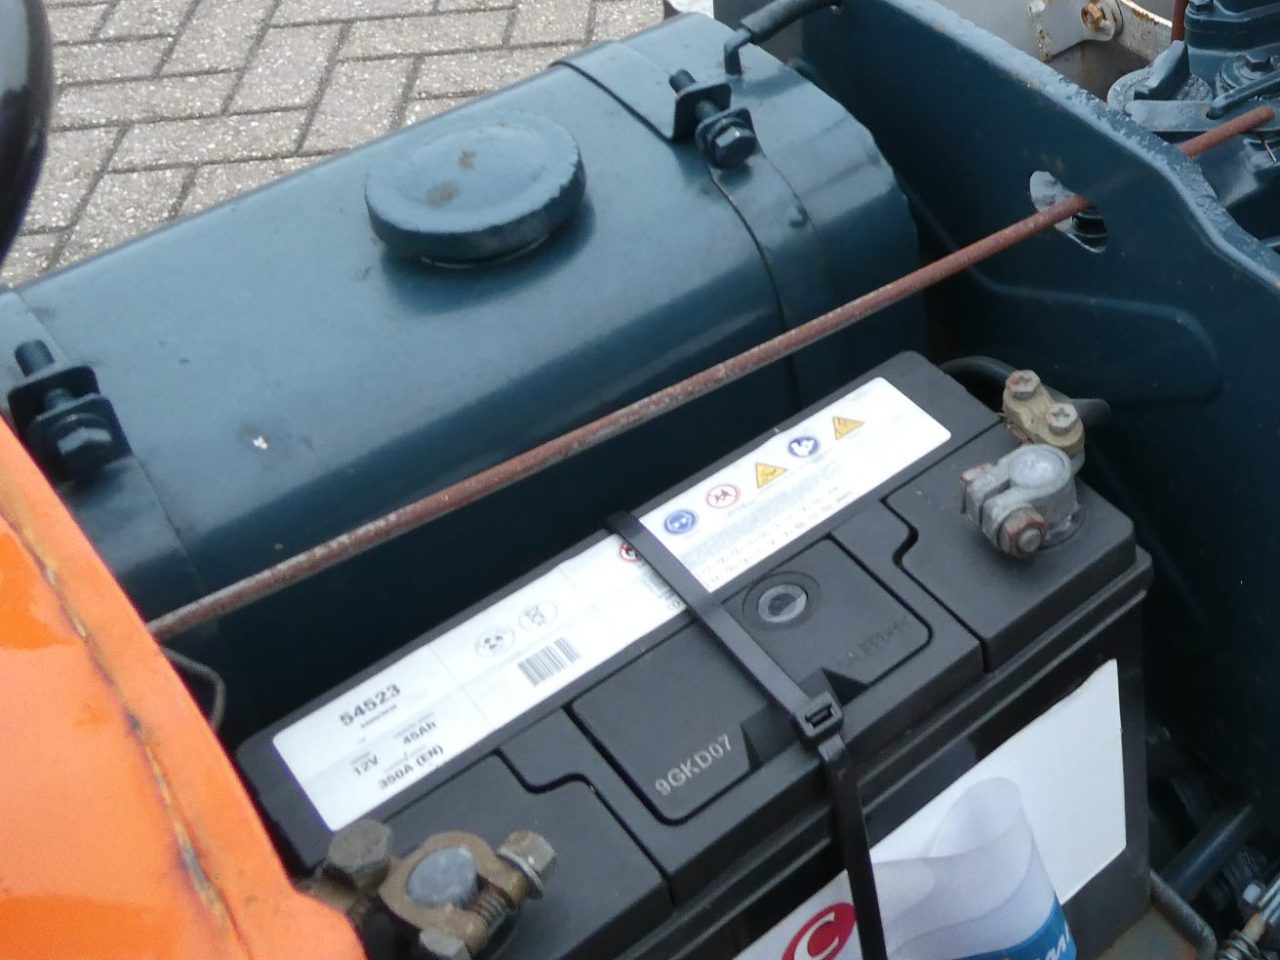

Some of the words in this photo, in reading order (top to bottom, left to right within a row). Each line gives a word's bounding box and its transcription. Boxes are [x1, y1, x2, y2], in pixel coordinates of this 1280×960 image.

[340, 684, 400, 726] 54523
[353, 755, 379, 776] 12V
[403, 721, 437, 745] 45Ah
[655, 734, 732, 796] 9GKD07
[379, 764, 414, 789] 350A
